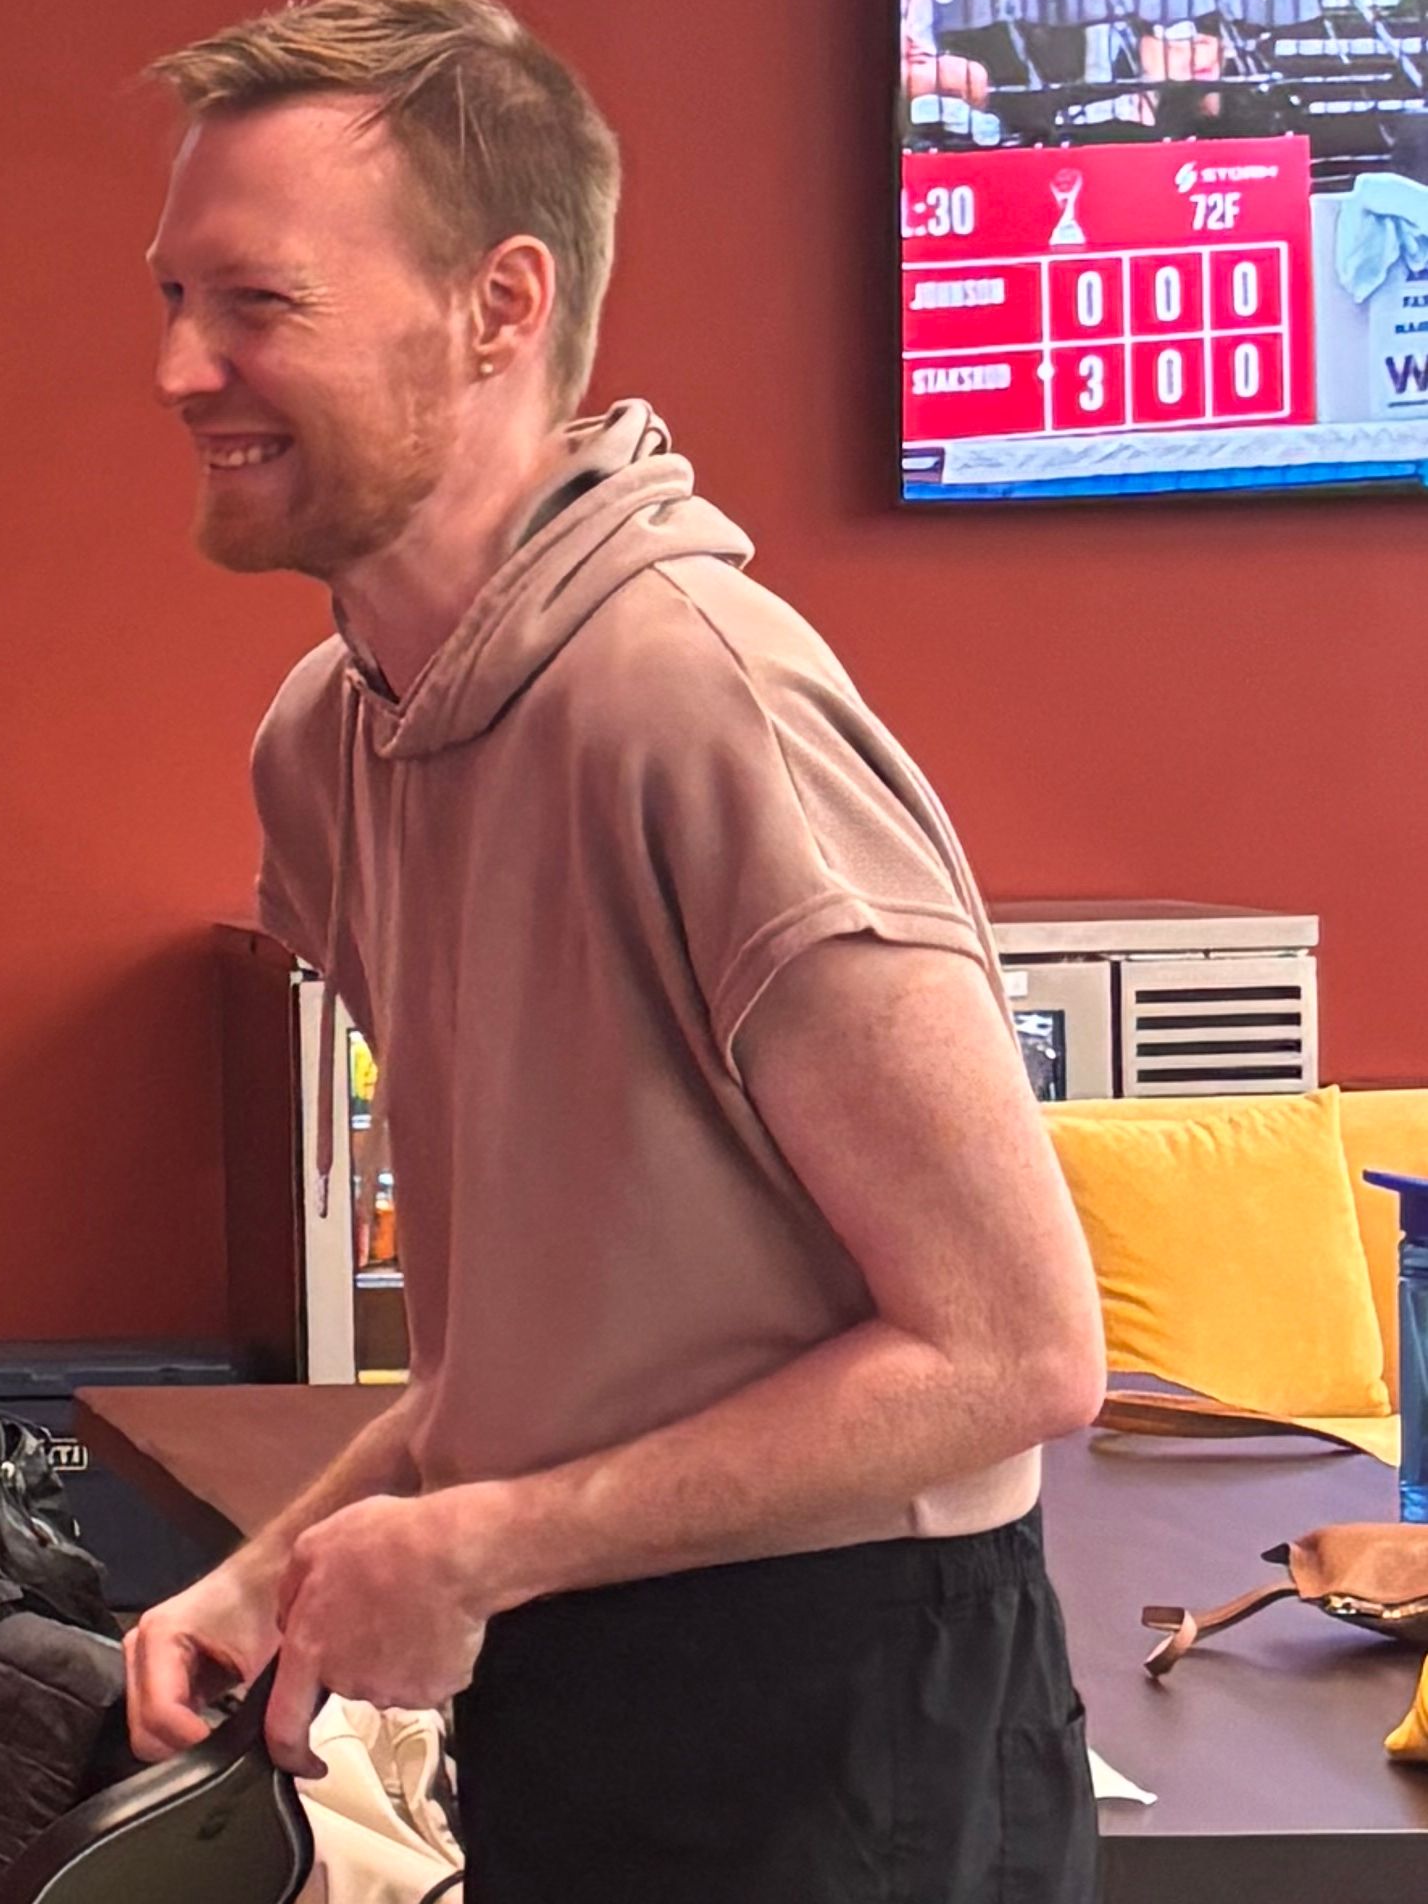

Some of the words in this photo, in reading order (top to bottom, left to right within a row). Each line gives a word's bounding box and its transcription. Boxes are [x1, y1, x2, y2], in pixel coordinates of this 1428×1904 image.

[1189, 191, 1242, 230] 72F
[1077, 270, 1104, 327] 0
[1155, 265, 1181, 322] 0
[1232, 261, 1258, 317] 0
[1079, 355, 1104, 411] 3
[1157, 349, 1183, 404] 0
[1234, 343, 1259, 398] 0
